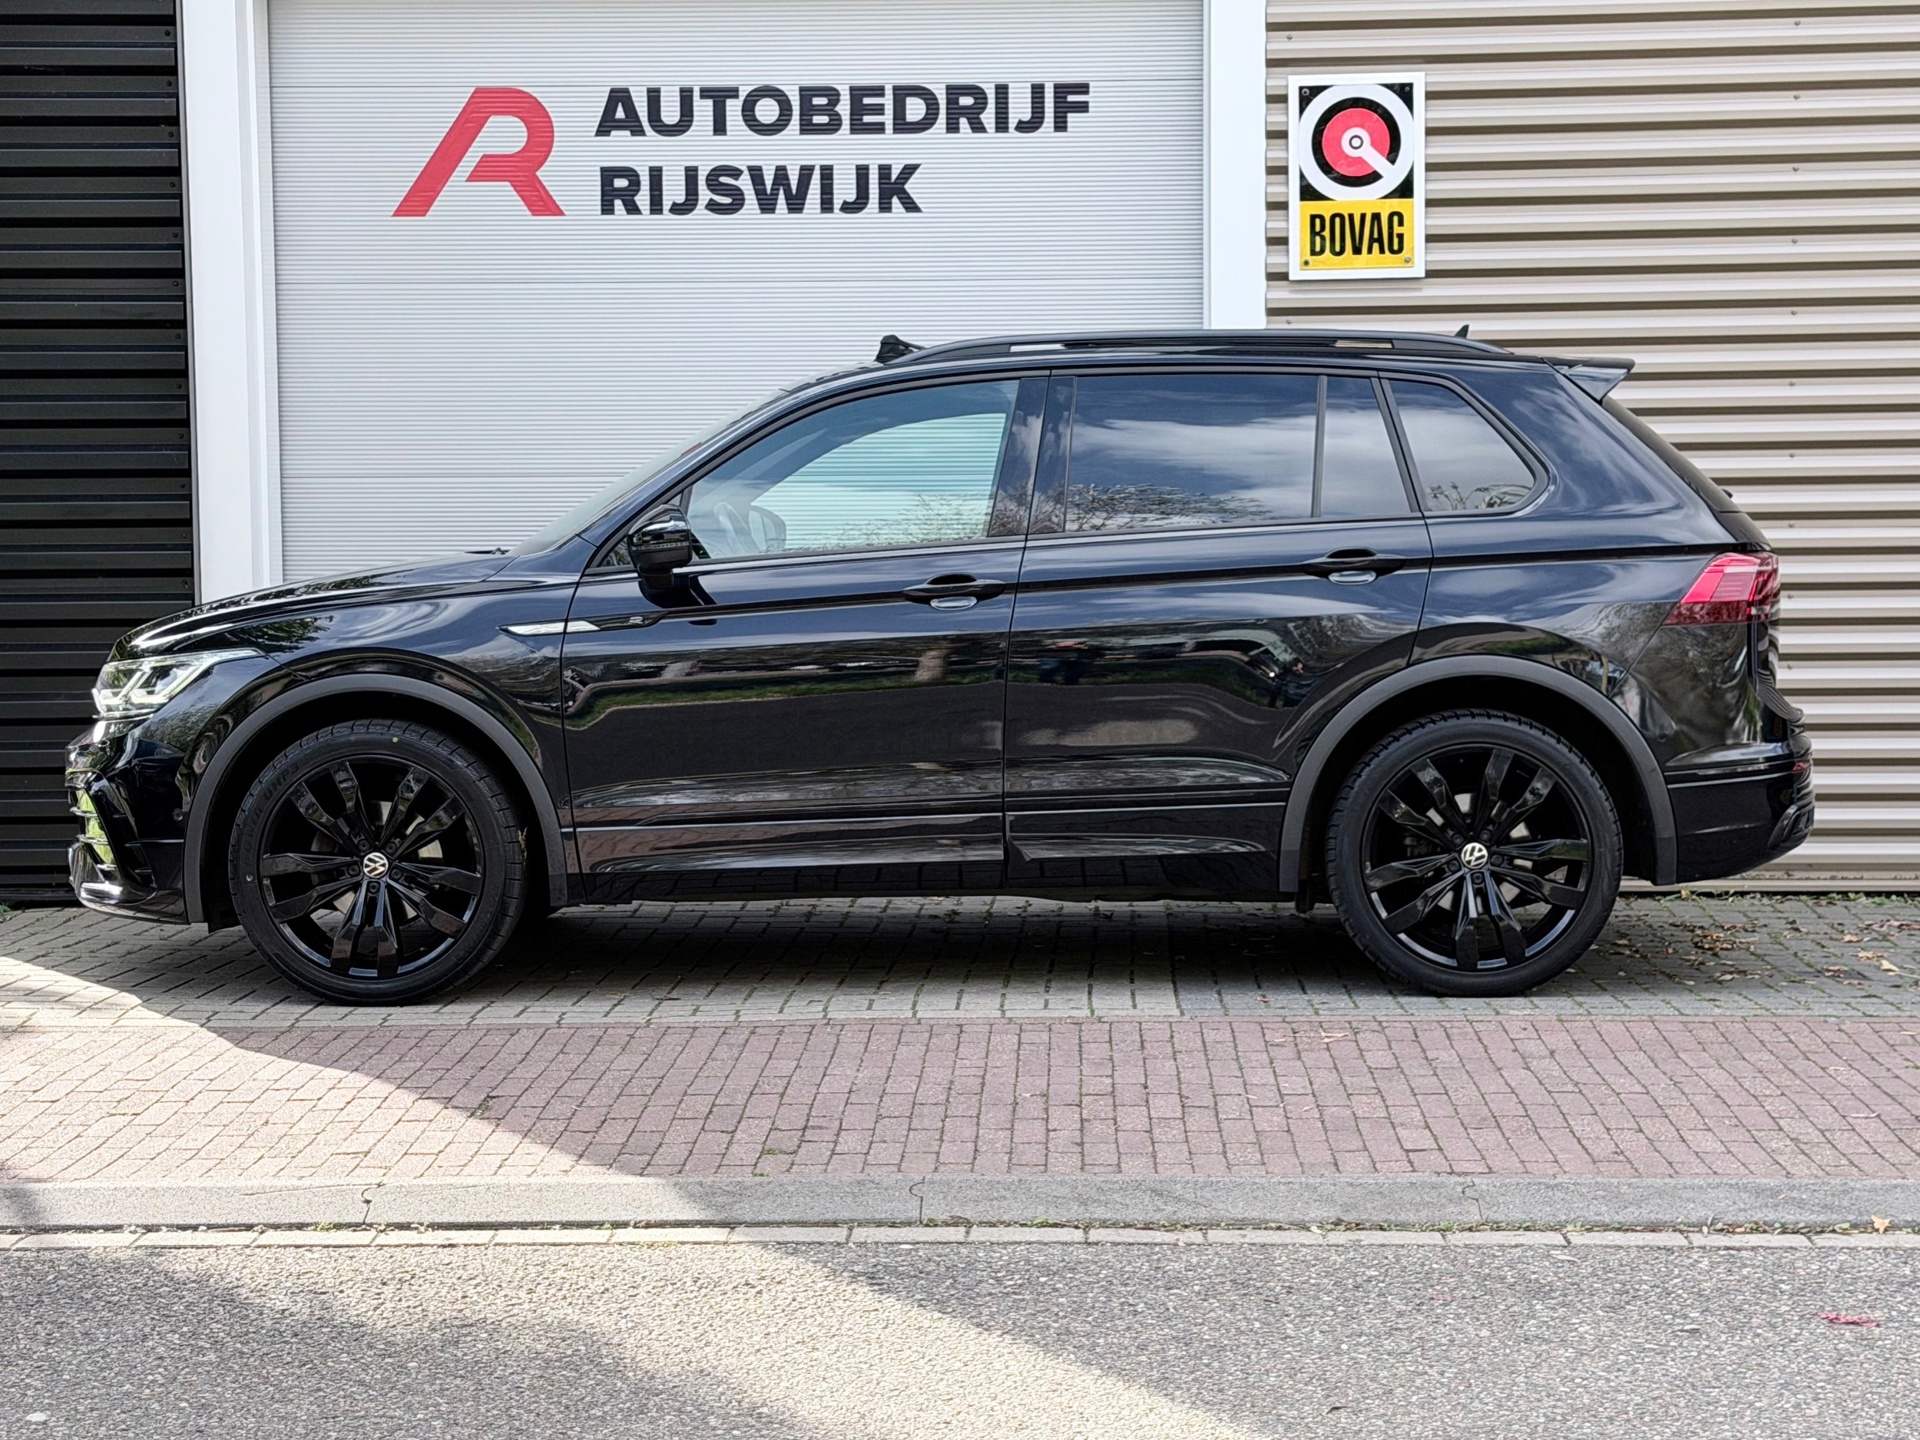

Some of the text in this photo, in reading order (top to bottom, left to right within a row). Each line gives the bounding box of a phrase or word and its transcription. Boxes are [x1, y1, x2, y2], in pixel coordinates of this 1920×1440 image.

[594, 83, 1090, 136] AUTOBEDRIJF
[600, 163, 923, 216] RIJSWIJK
[1309, 211, 1405, 257] BOVAG
